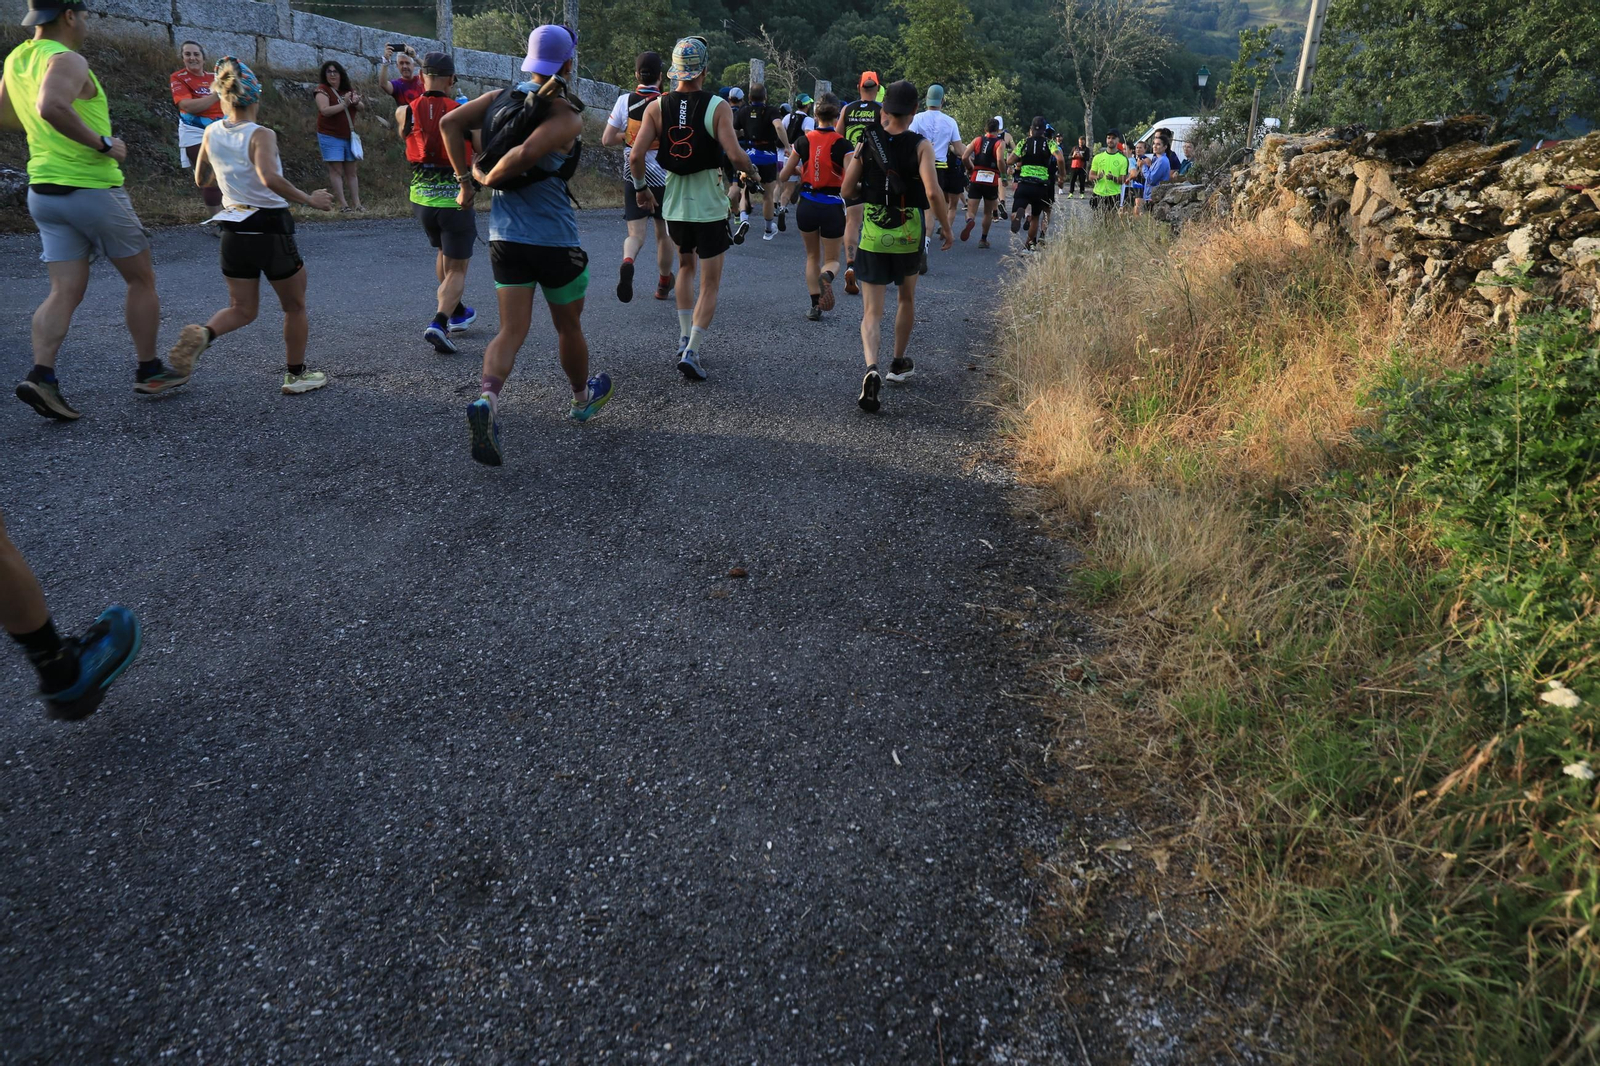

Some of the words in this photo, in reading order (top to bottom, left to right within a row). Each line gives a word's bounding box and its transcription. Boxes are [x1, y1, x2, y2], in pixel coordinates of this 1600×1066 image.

[678, 99, 688, 130] TERREX
[814, 145, 822, 182] salomon
[870, 130, 889, 164] SALOMON
